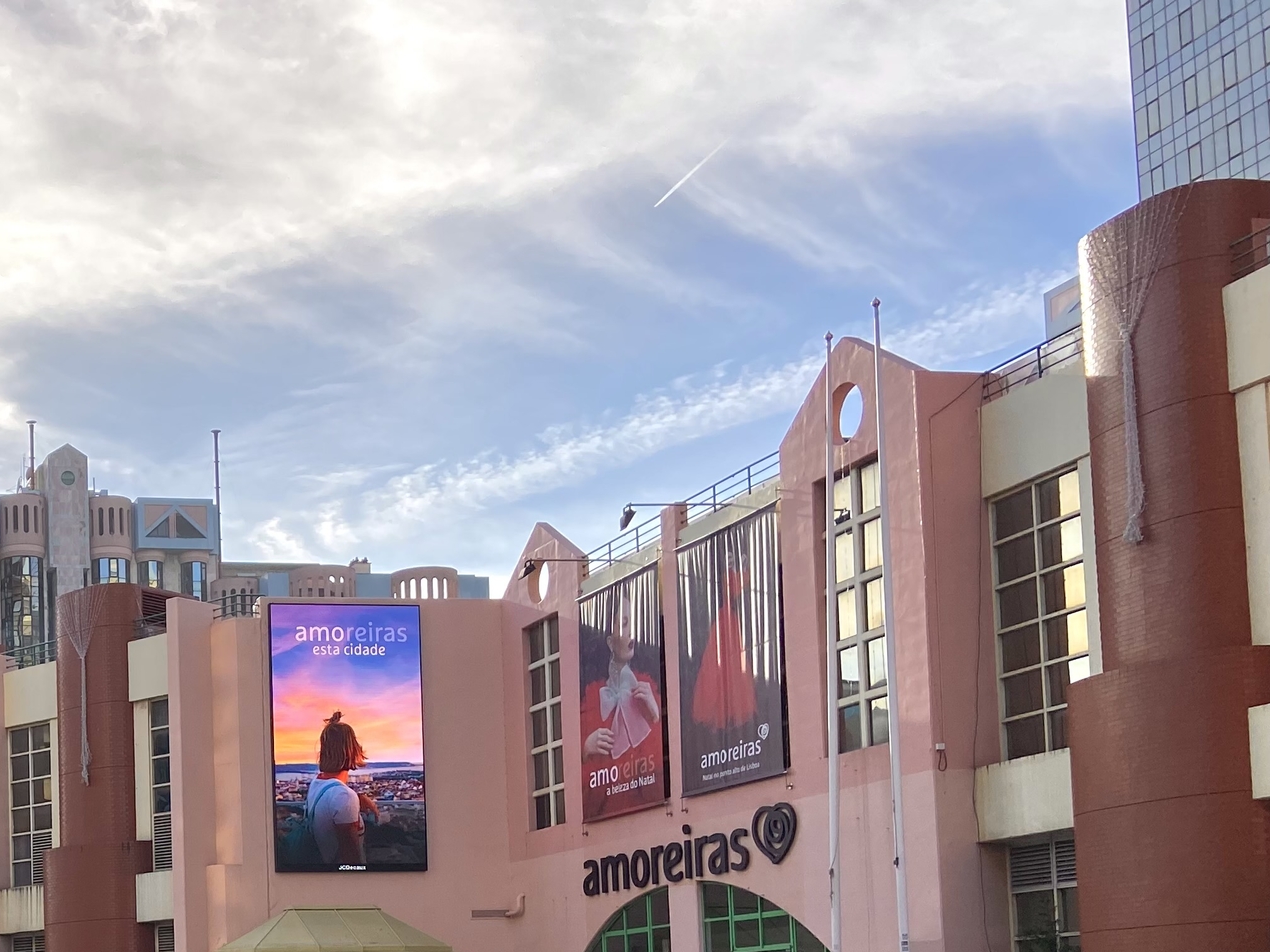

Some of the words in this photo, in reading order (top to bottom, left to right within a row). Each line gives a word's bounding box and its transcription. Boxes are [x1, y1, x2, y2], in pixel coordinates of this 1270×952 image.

[295, 621, 408, 642] amoreiras
[312, 645, 340, 656] esta
[343, 642, 386, 656] cidade
[700, 739, 762, 769] amoreiras
[589, 753, 656, 788] amoreiras
[606, 787, 611, 796] a
[611, 783, 629, 795] beleza
[630, 778, 638, 789] do
[638, 772, 655, 787] Natal
[583, 823, 750, 897] amoreiras
